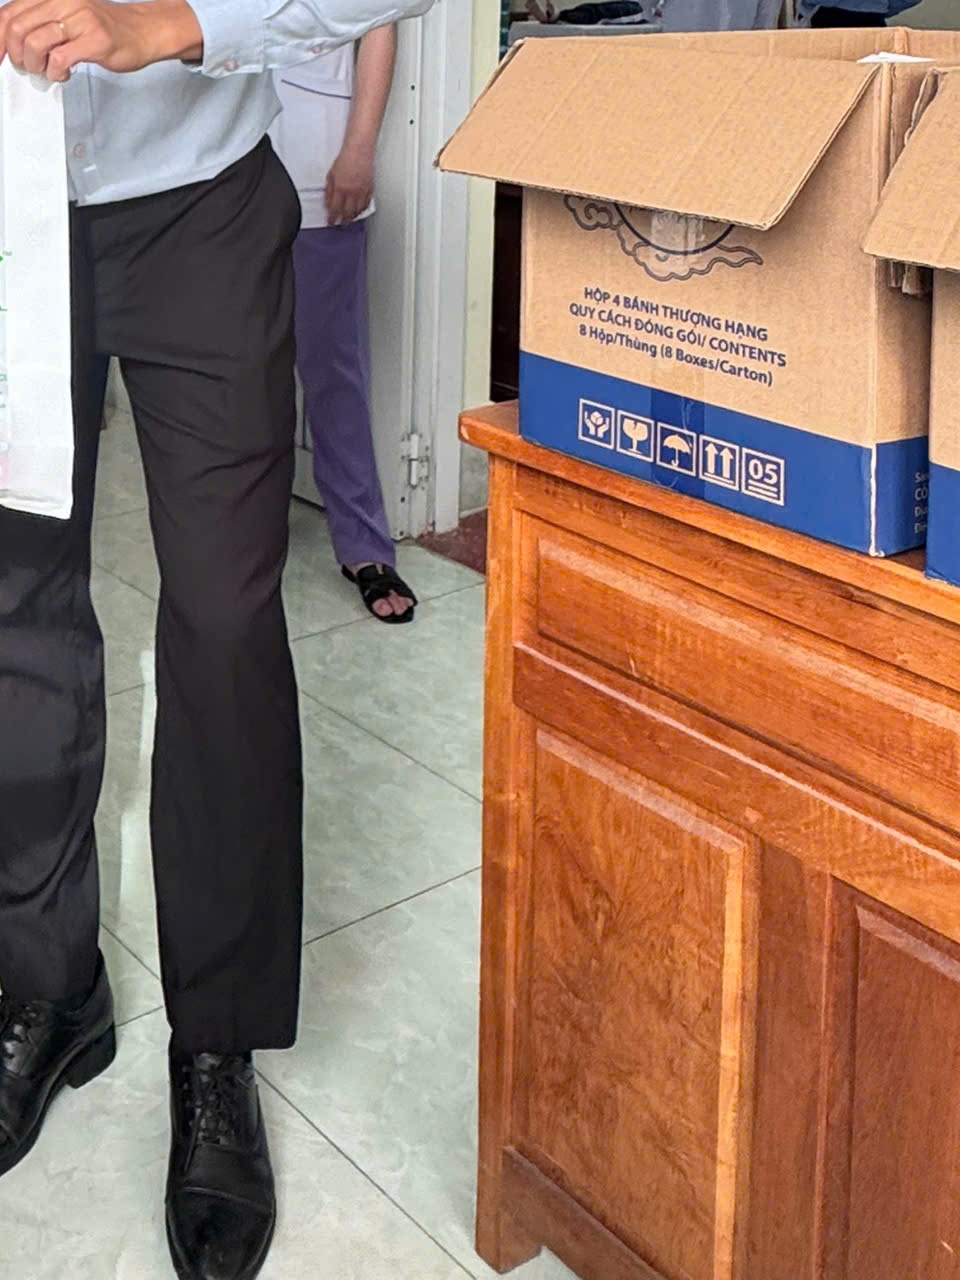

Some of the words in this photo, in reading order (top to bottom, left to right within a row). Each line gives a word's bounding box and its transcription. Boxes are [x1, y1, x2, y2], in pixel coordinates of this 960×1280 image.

[569, 303, 596, 319] QUY
[598, 309, 632, 329] CÁCH
[634, 318, 674, 339] ĐÓNG
[709, 337, 787, 368] CONTENTS
[584, 287, 611, 305] HỘP
[613, 295, 621, 307] 4
[623, 296, 659, 316] BÁNH
[661, 305, 722, 331] THƯỢNG
[725, 320, 768, 342] HẠNG
[579, 324, 587, 336] 8
[589, 326, 658, 358] Hộp/Thùng
[660, 344, 673, 359] (8
[675, 348, 773, 388] Boxes/Carton)
[749, 458, 778, 484] 05
